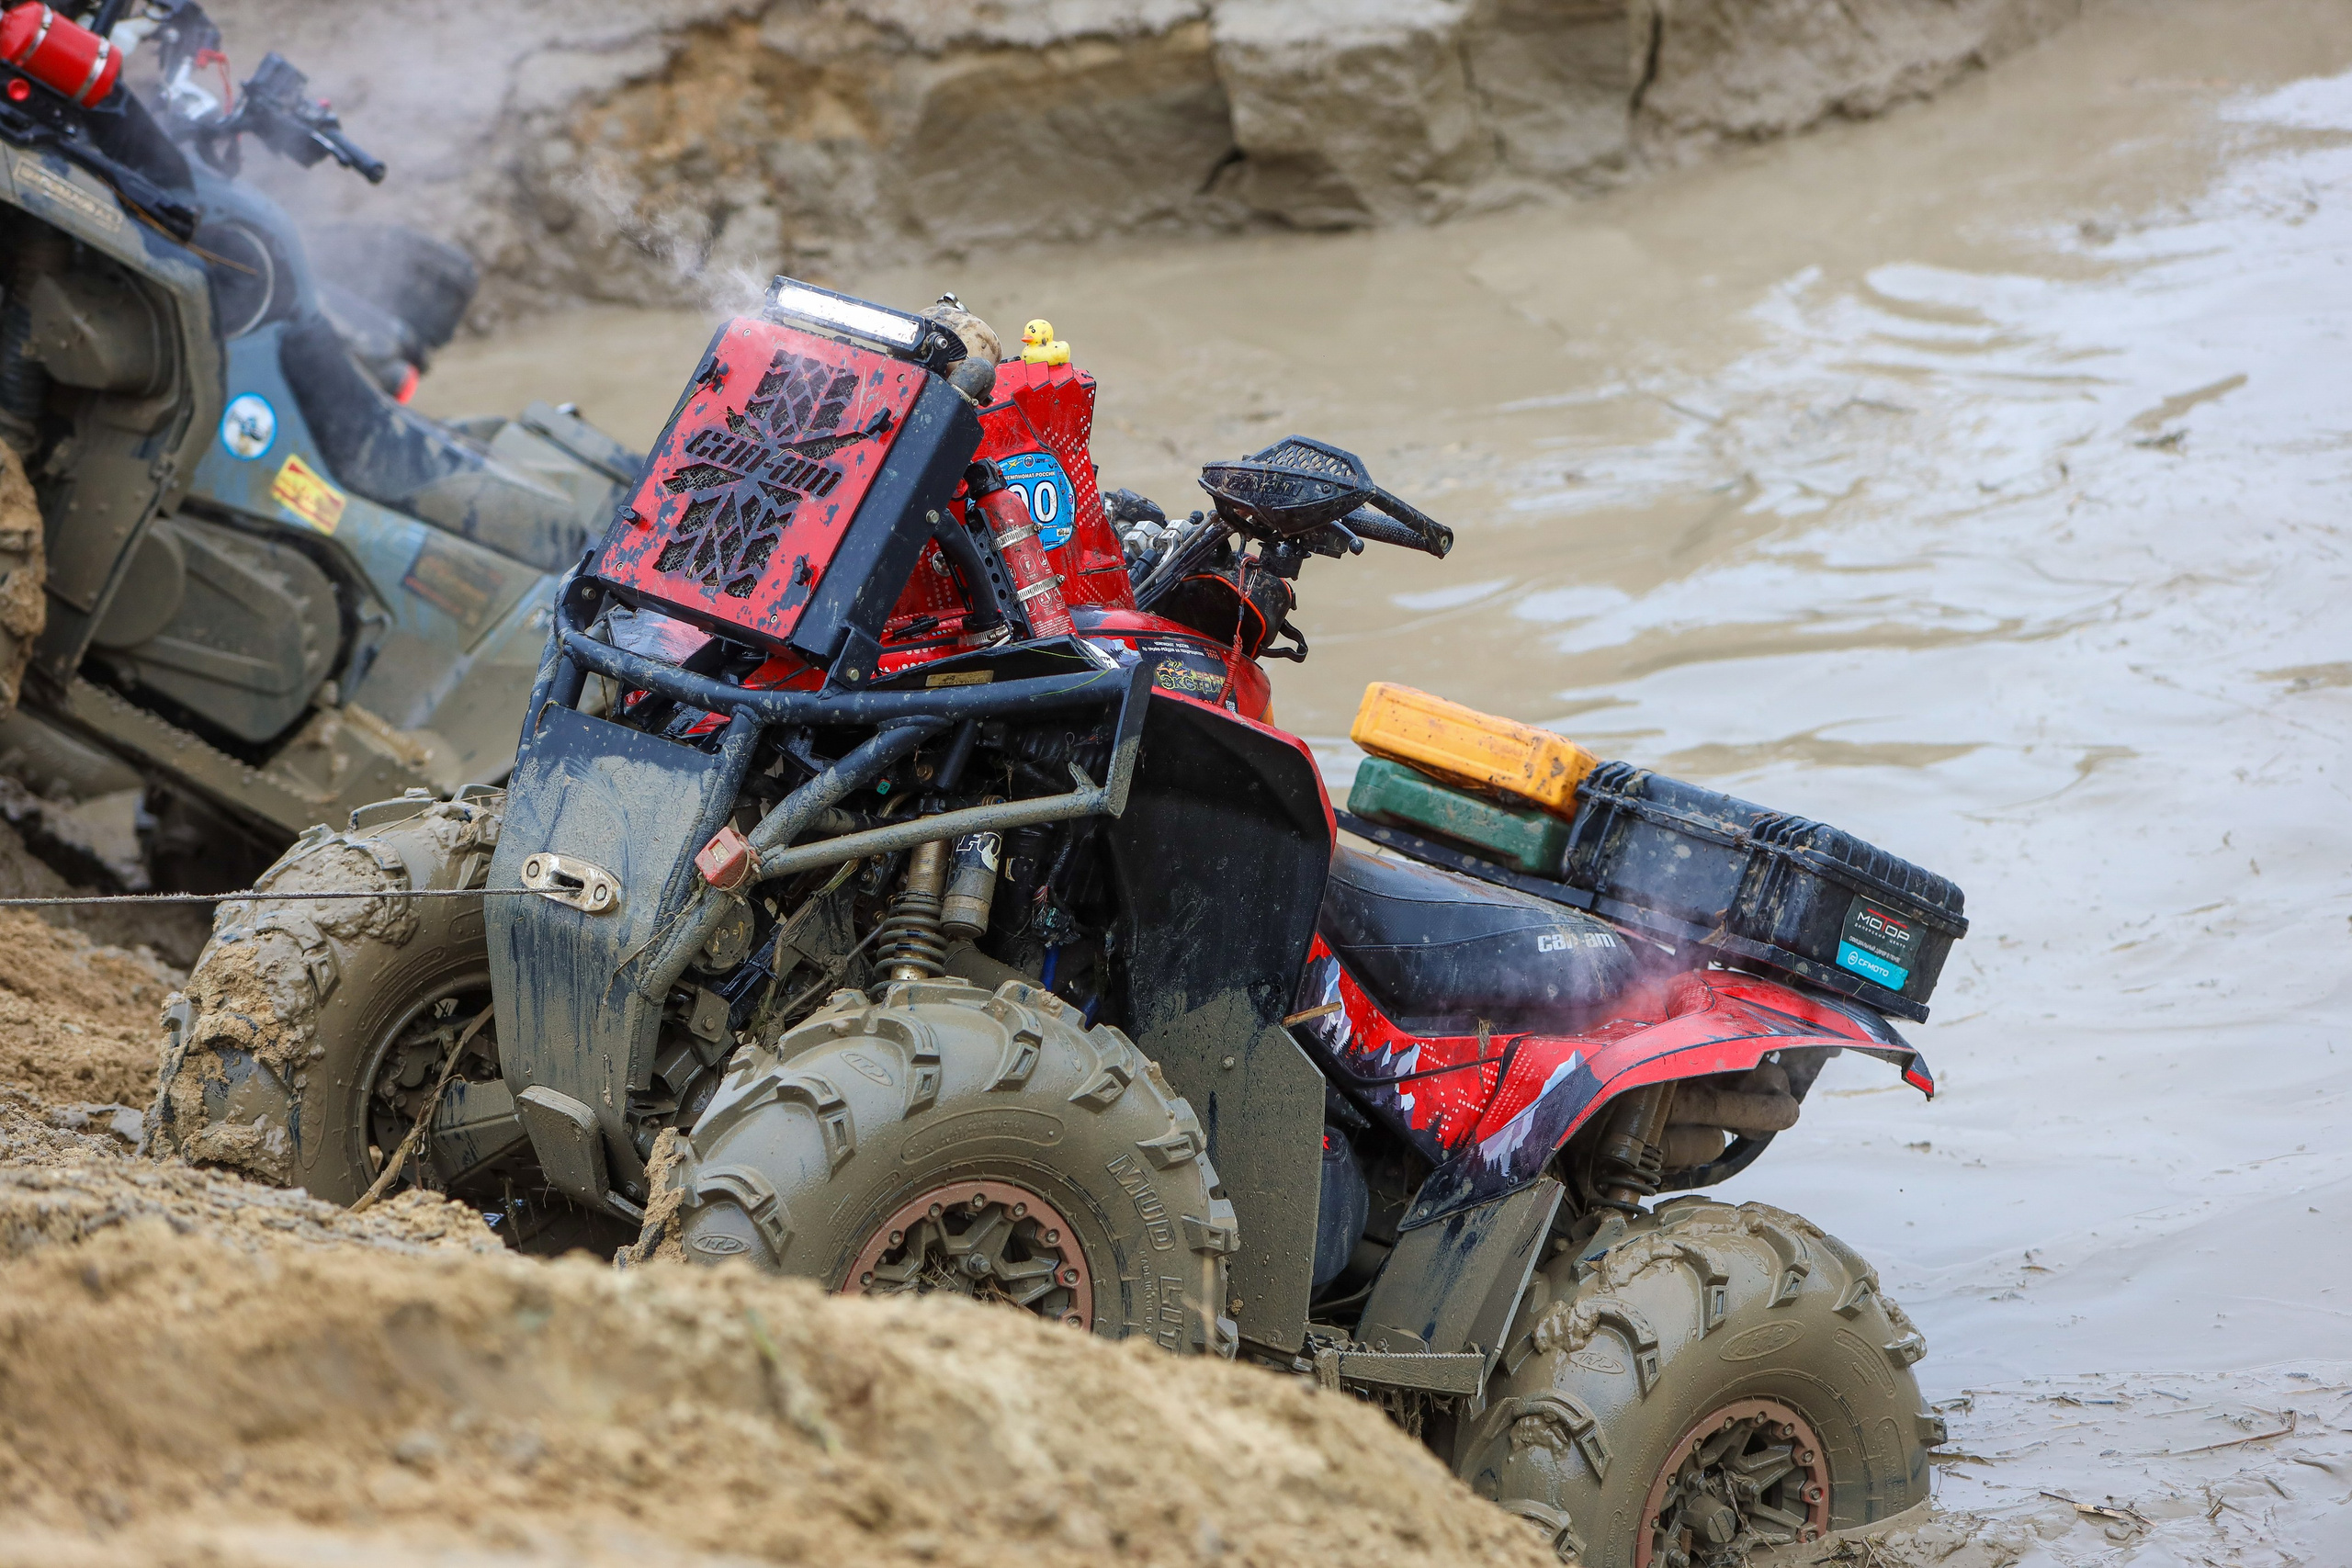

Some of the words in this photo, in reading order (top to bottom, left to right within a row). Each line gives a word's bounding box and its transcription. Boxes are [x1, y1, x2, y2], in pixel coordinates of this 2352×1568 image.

[1159, 674, 1224, 694] ЭКСТРИ
[1858, 958, 1889, 977] CFMOTO
[1106, 1154, 1176, 1250] MUD
[1158, 1276, 1183, 1358] LIT
